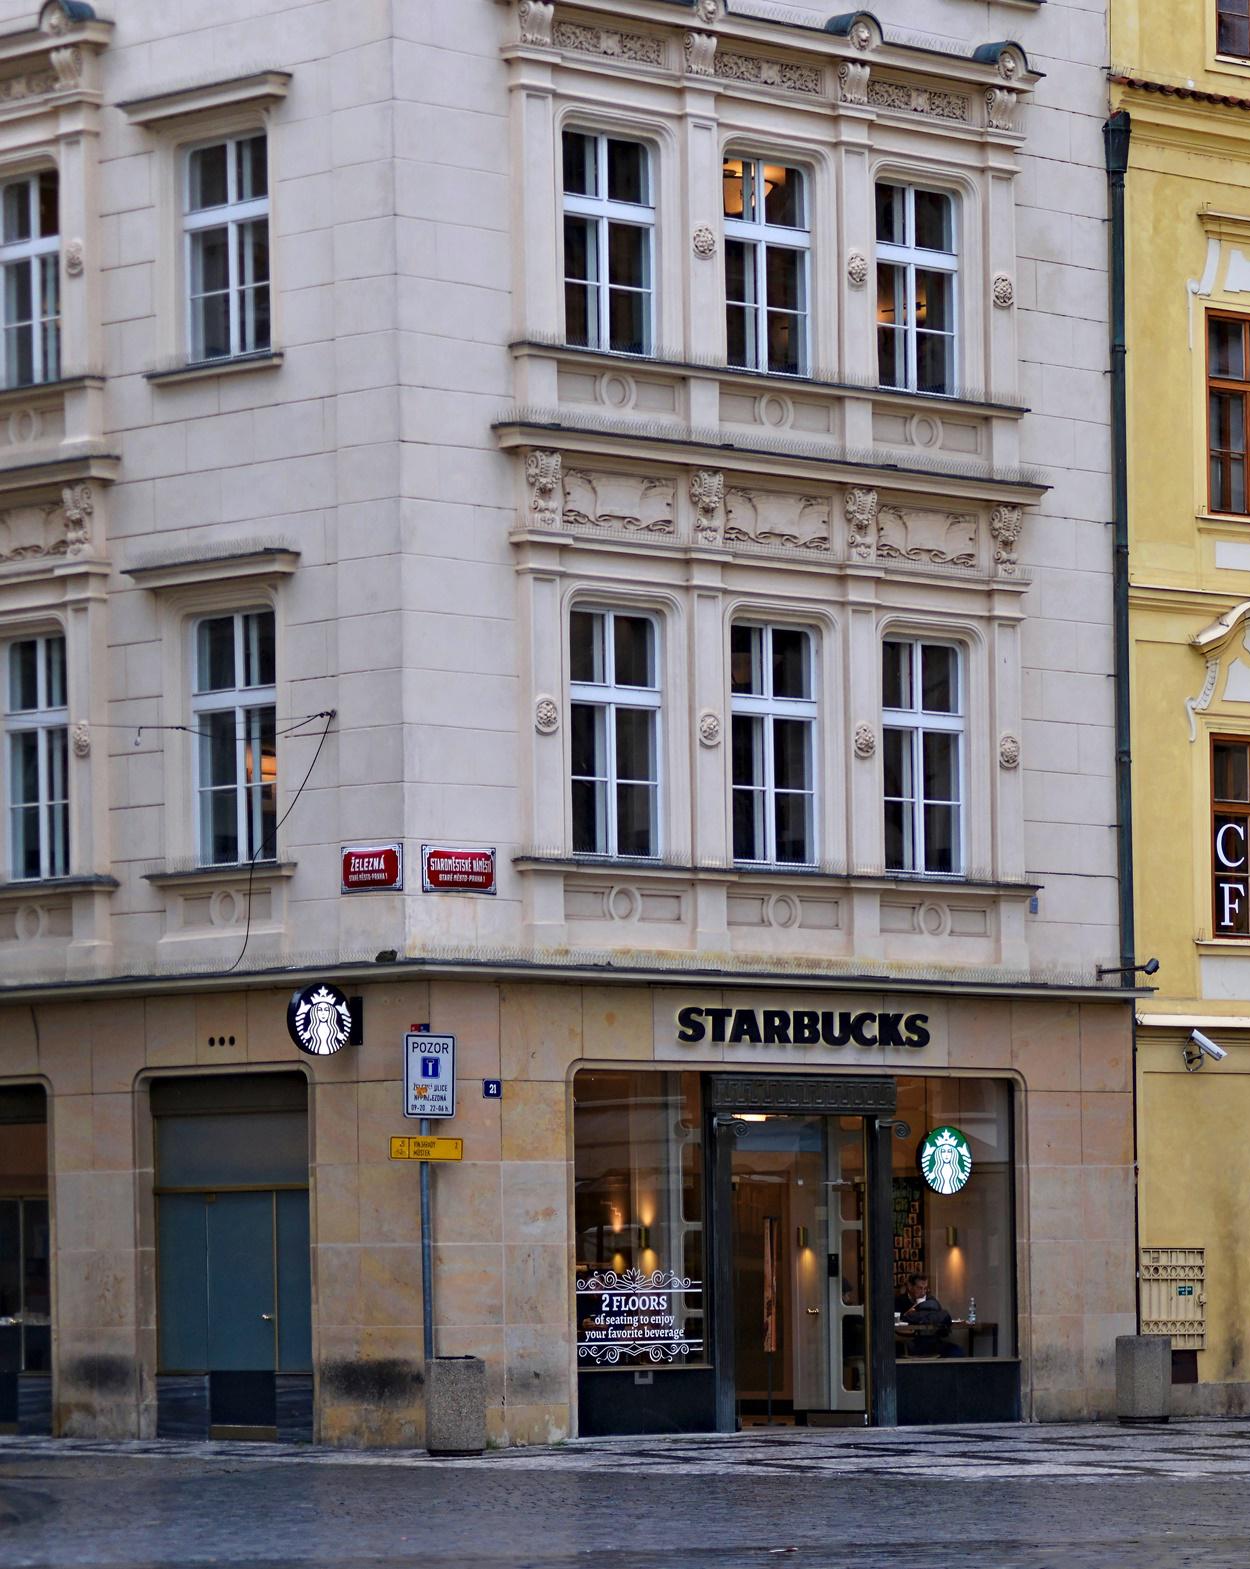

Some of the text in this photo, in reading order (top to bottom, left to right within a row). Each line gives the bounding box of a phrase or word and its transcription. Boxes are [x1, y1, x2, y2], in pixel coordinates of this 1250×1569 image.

[350, 855, 385, 872] ŽELEZNÁ
[430, 855, 471, 873] STAROMĚSTSKÉ
[678, 1006, 930, 1047] STARBUCKS
[412, 1042, 449, 1054] POZOR
[489, 1084, 497, 1094] 21
[601, 1294, 667, 1311] 2 FLOORS
[594, 1313, 675, 1327] of seating to enjoy
[585, 1326, 684, 1341] your favorite beverage
